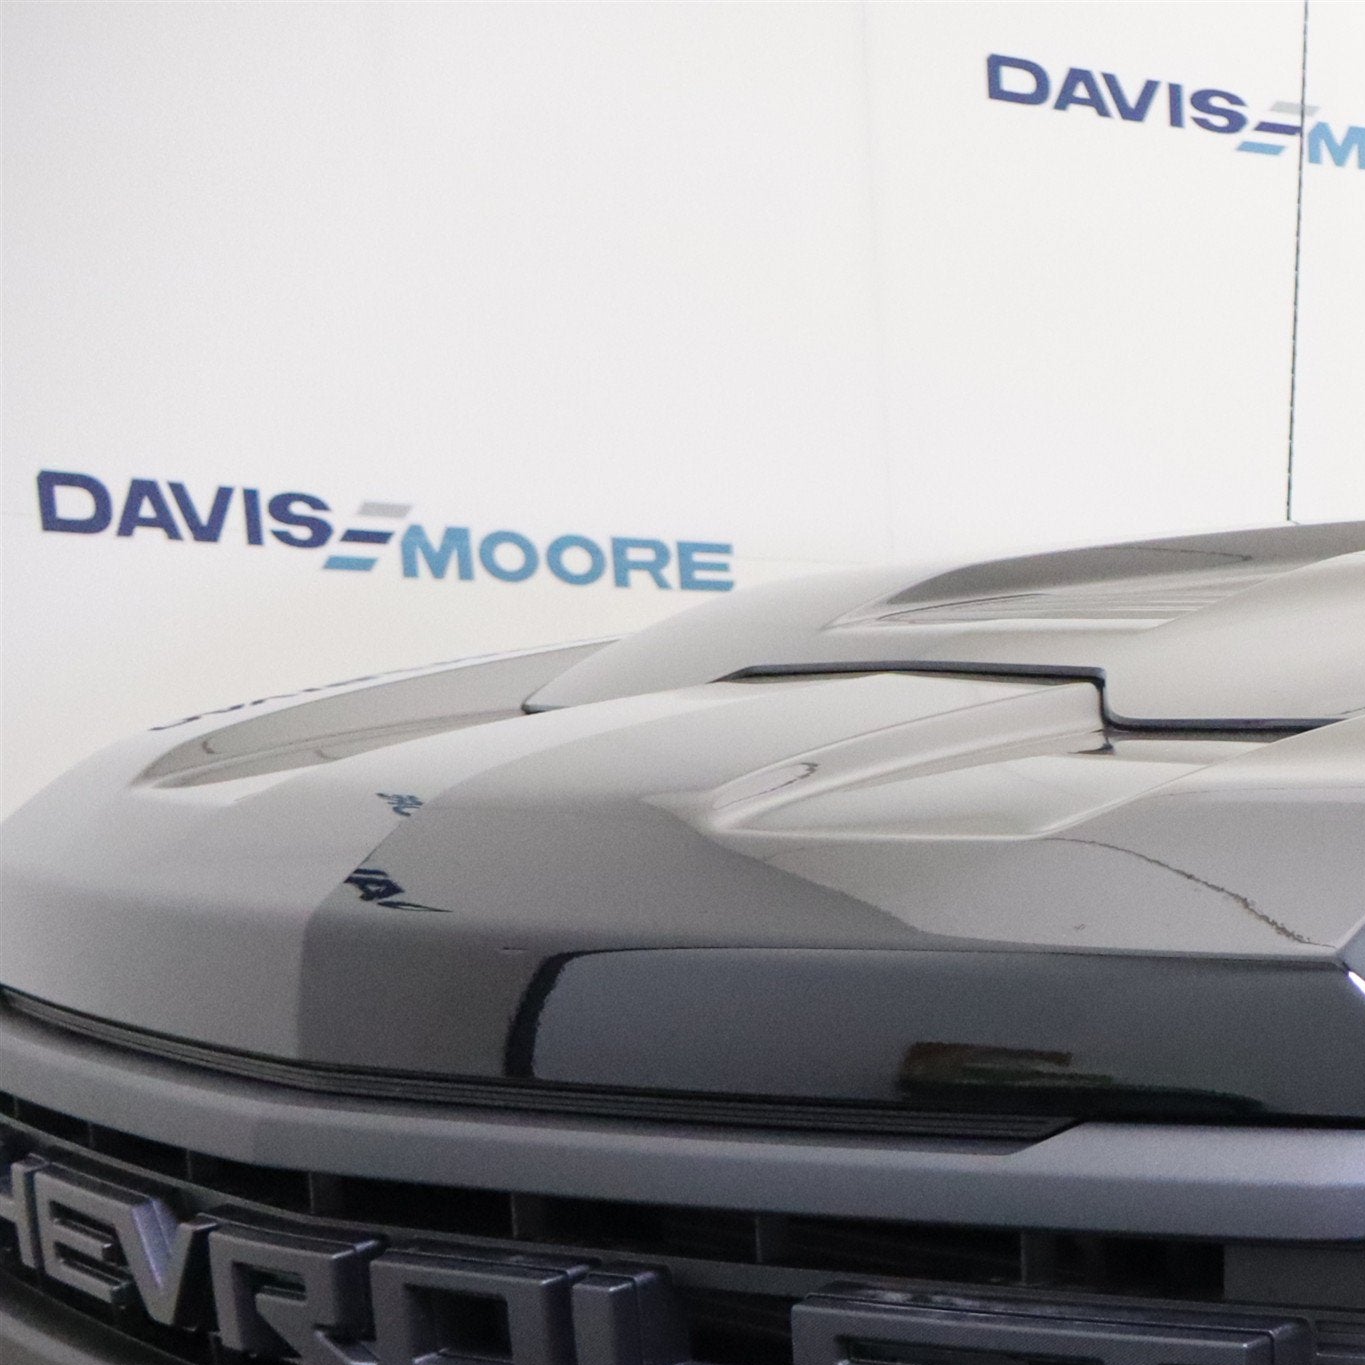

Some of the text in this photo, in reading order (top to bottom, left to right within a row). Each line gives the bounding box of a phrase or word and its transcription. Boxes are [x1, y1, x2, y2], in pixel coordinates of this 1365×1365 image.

[986, 52, 1248, 135] DAVIS
[36, 469, 735, 593] DAVIS MOORE
